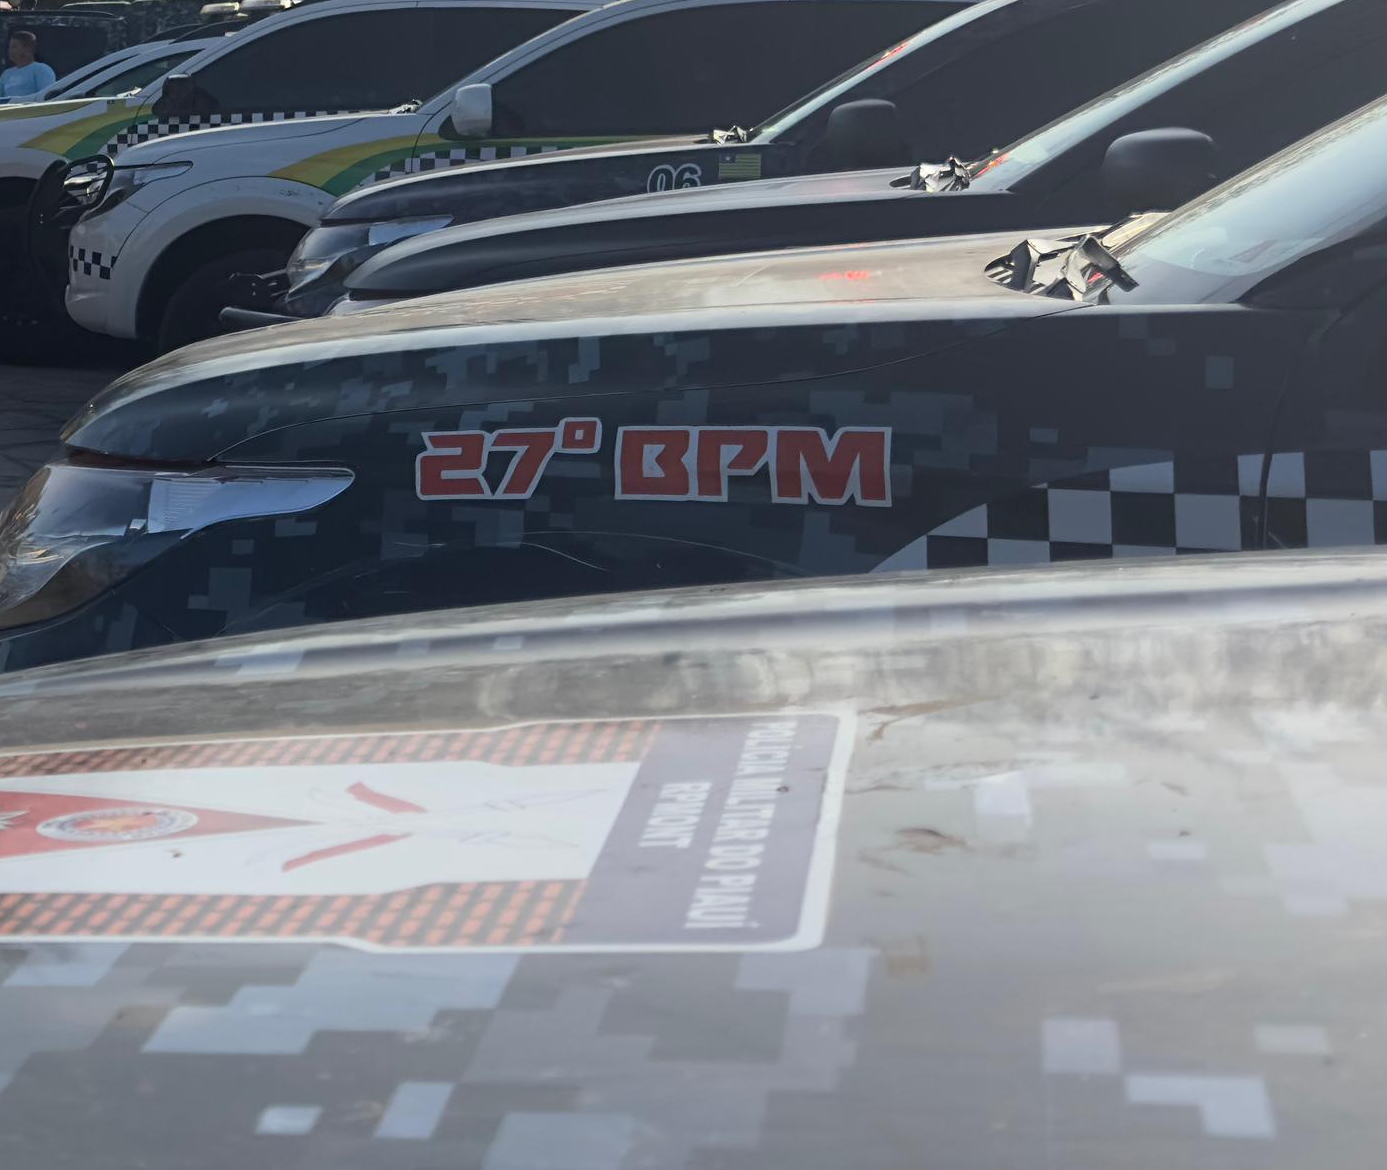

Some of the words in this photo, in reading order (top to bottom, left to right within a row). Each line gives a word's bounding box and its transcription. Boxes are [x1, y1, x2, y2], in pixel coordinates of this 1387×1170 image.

[615, 426, 893, 507] BPM
[637, 781, 714, 849] RPMONT
[711, 777, 783, 843] MILITAR
[703, 843, 765, 870] DO
